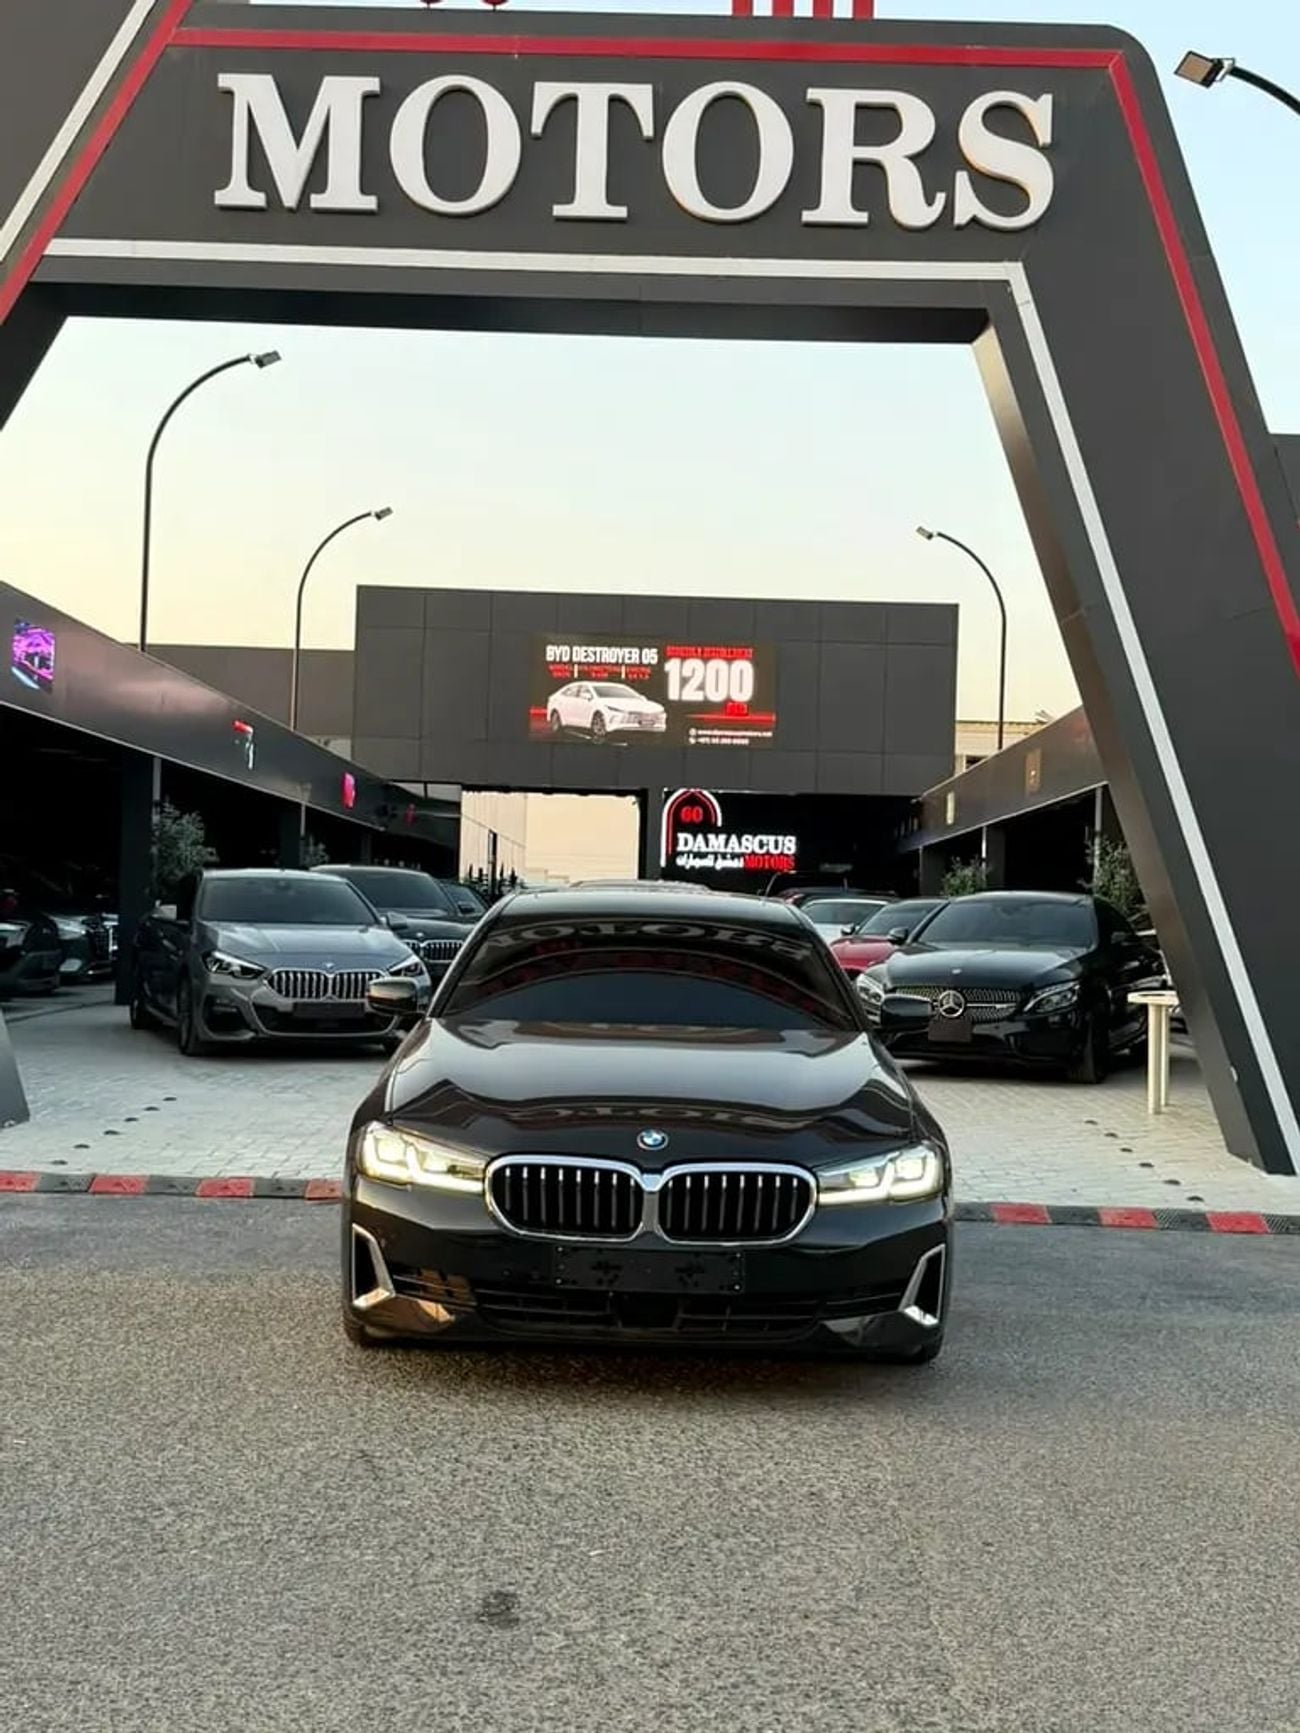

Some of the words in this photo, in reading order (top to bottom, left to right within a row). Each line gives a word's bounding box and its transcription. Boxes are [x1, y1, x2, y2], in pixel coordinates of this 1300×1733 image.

[214, 72, 1056, 232] MOTORS
[546, 645, 570, 662] BYD
[572, 646, 640, 664] DESTROYER
[642, 648, 659, 664] 05
[664, 659, 754, 702] 1200
[676, 833, 797, 854] DAMASCUS
